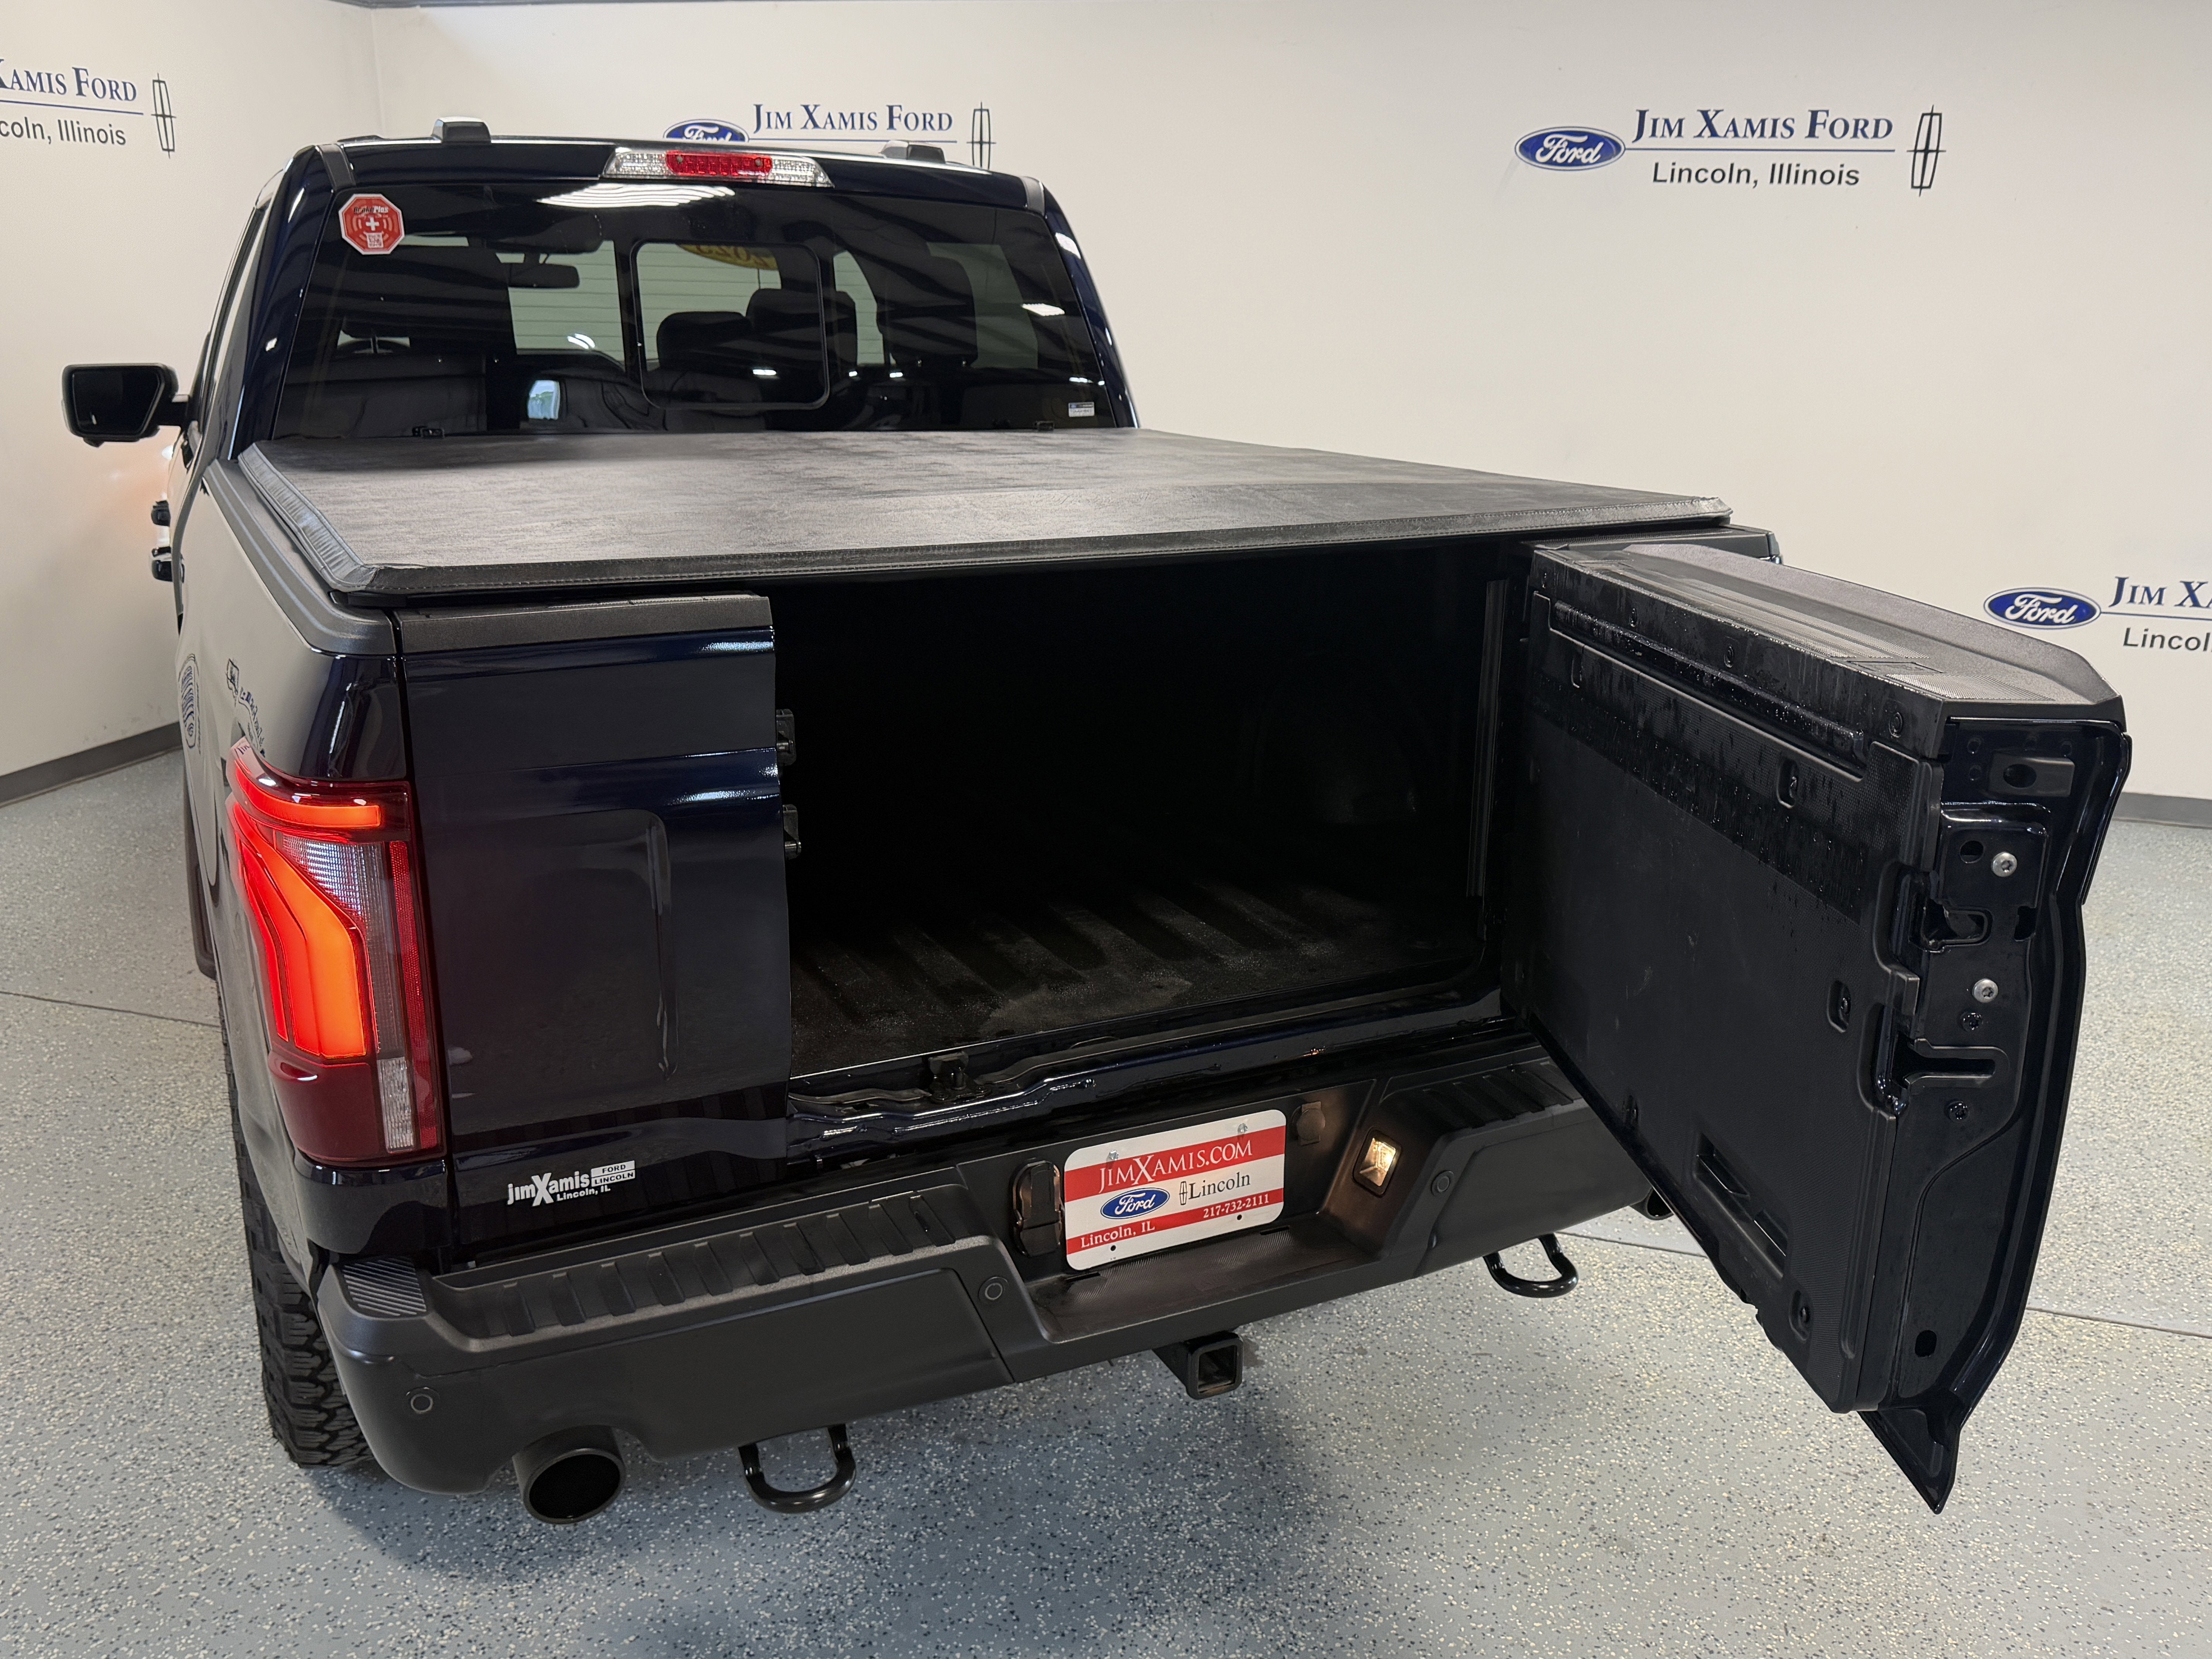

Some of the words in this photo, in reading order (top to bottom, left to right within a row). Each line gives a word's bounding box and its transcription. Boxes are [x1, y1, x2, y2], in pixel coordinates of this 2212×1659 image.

[72, 67, 137, 101] FORD
[58, 119, 126, 145] Illinois
[753, 104, 793, 134] JIM
[800, 104, 878, 131] XAMIS
[886, 105, 953, 131] FORD
[1632, 109, 1685, 143] JIM
[1693, 109, 1795, 139] XAMIS
[1805, 109, 1893, 139] FORD
[1535, 134, 1604, 163] Ford
[1653, 161, 1759, 188] Lincoln,
[1769, 163, 1860, 185] Illinois
[2108, 576, 2167, 608] JIM
[2004, 593, 2078, 624] Ford
[2123, 627, 2212, 652] Lincol
[594, 1172, 634, 1185] LINCOLN
[602, 1164, 626, 1174] FORD
[1099, 1140, 1253, 1194] JIMXAMIS.COM
[556, 1187, 598, 1201] Lincoln,
[601, 1185, 611, 1193] IL
[1188, 1172, 1251, 1199] Lincoln
[1115, 1192, 1156, 1215] Ford
[1203, 1194, 1269, 1219] 217-732-2111
[1080, 1226, 1136, 1248] Lincoln,
[1141, 1221, 1155, 1233] IL
